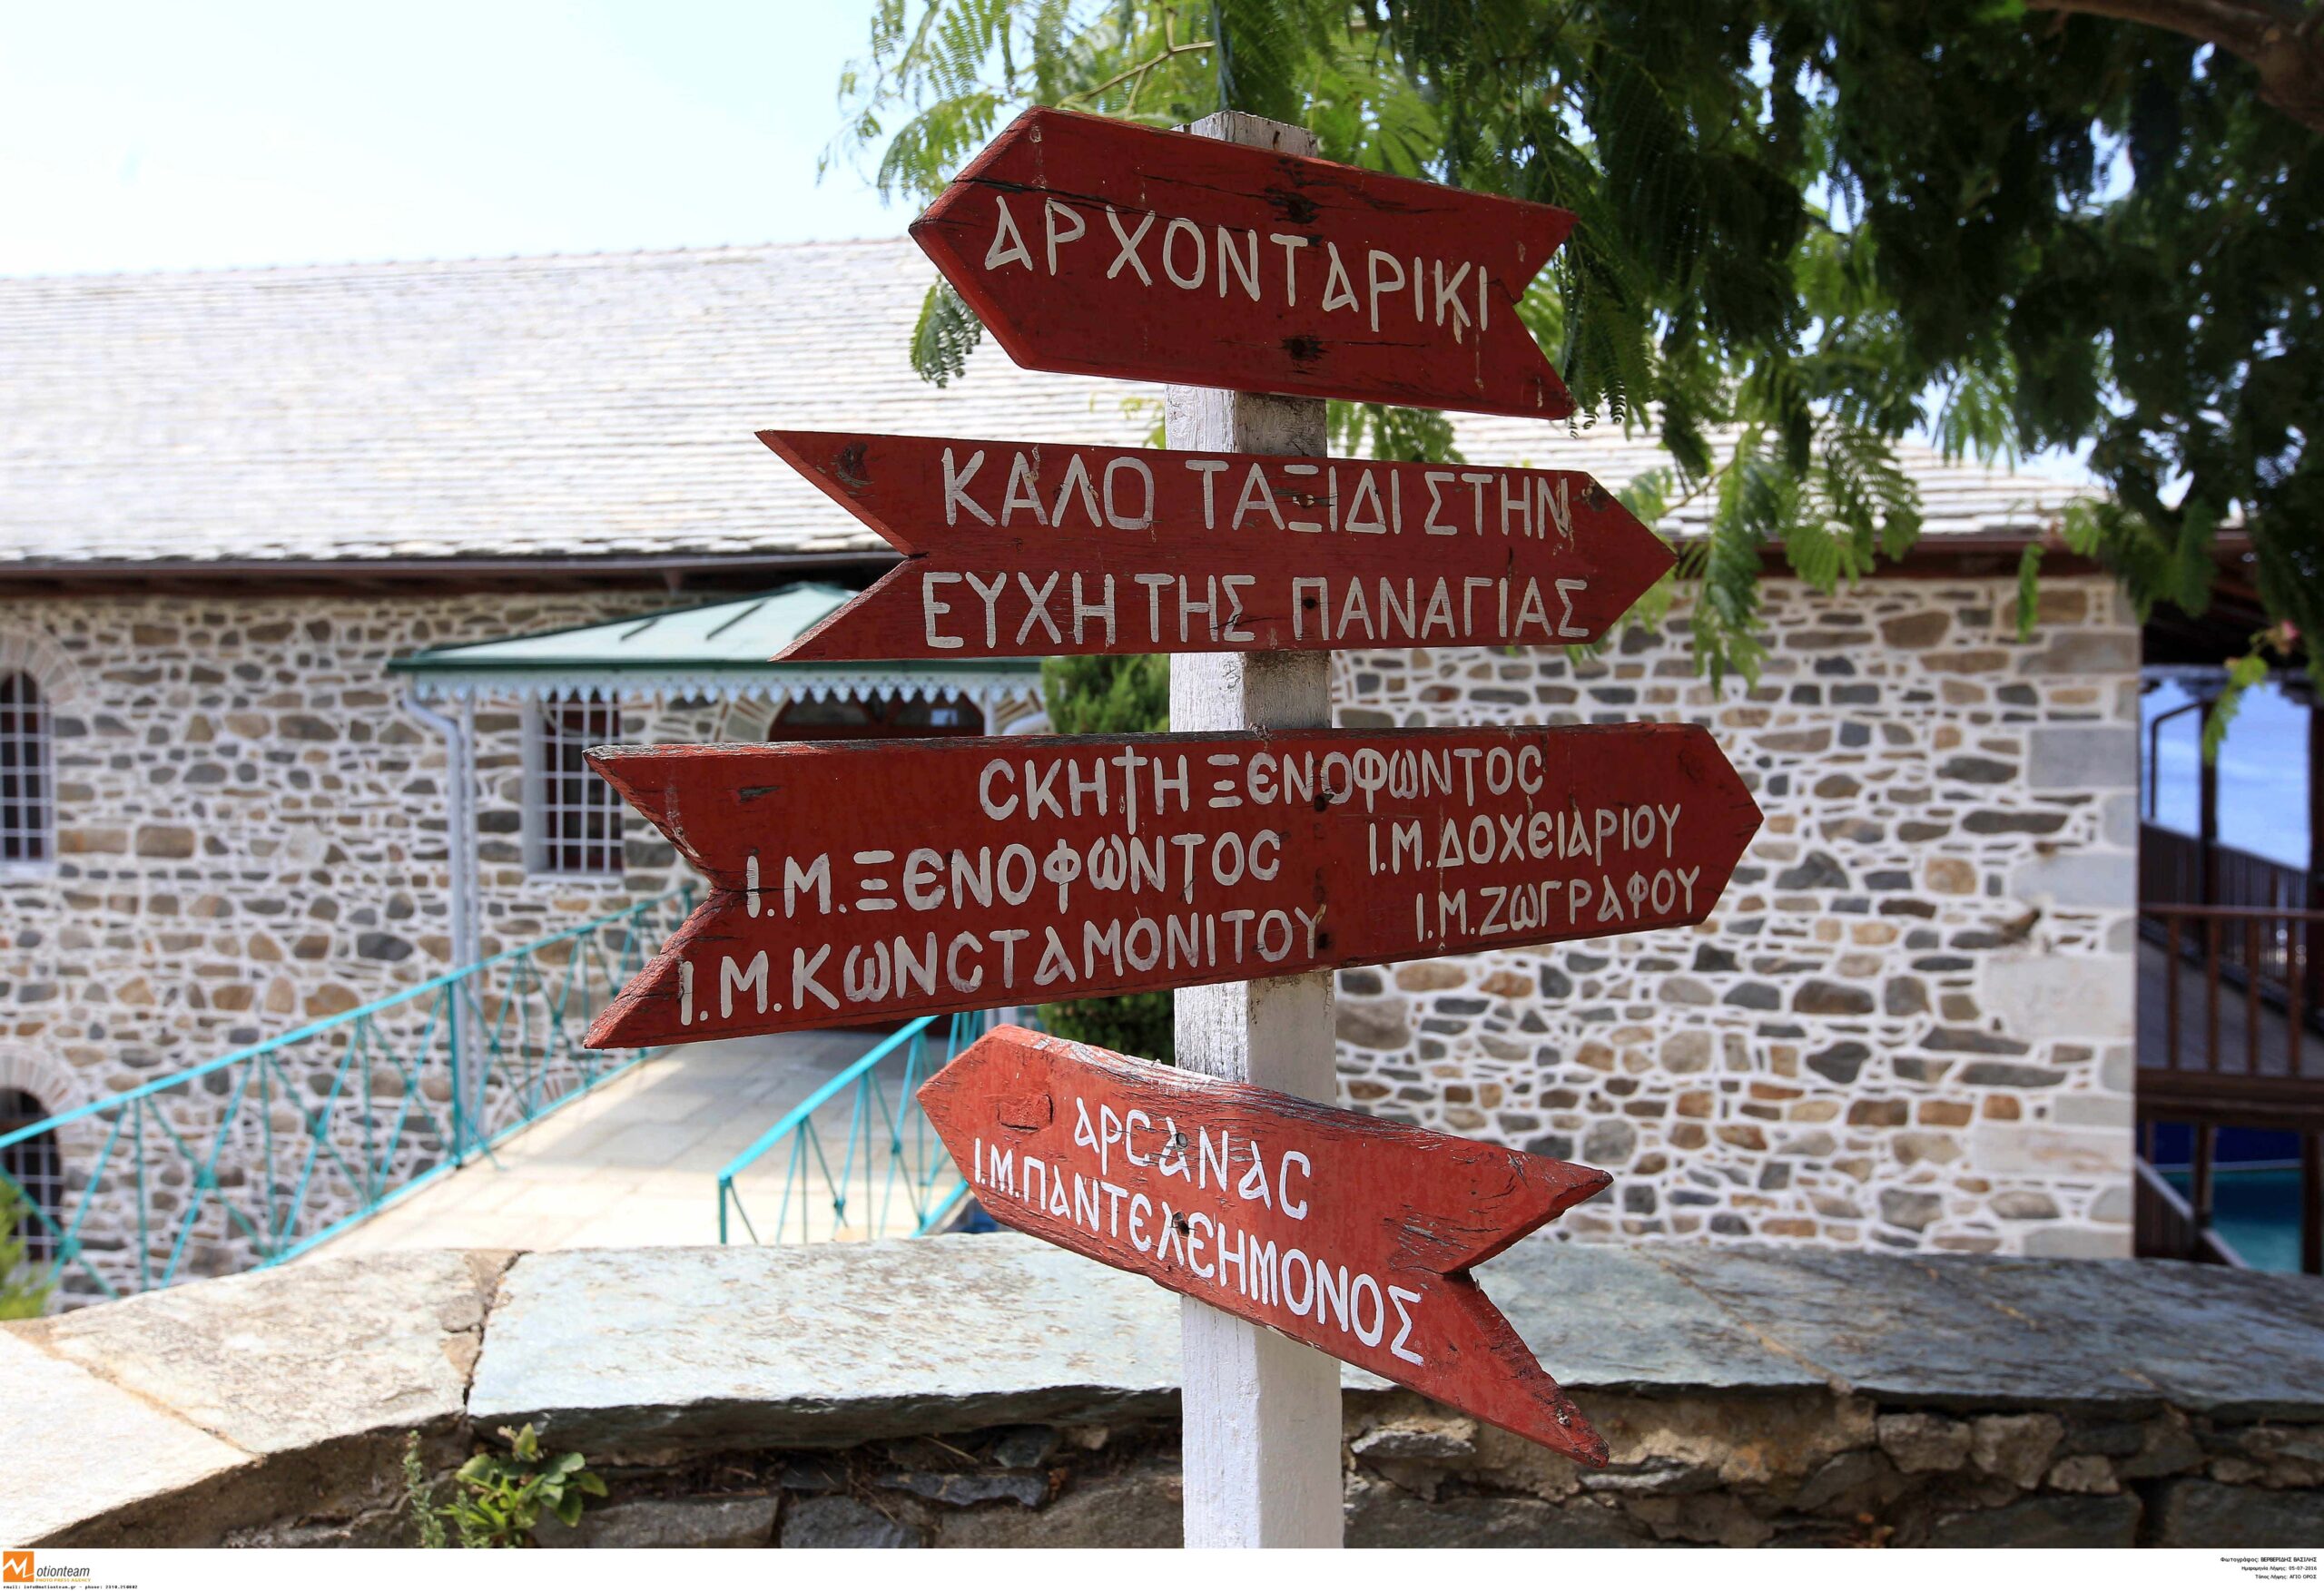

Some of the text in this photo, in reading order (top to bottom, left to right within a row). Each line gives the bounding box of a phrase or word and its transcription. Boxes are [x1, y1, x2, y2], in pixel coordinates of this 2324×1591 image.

[985, 195, 1490, 334] ΑΡΧΟΝΤΑΡΙΚΙ
[940, 447, 1571, 540] ΚΑΛΟ ΤΑΞΙΔΙ ΣΤΗΝ
[922, 571, 1590, 650] ΕΥΧΗ ΤΗΣ ΠΑΝΑΓΙΑΣ
